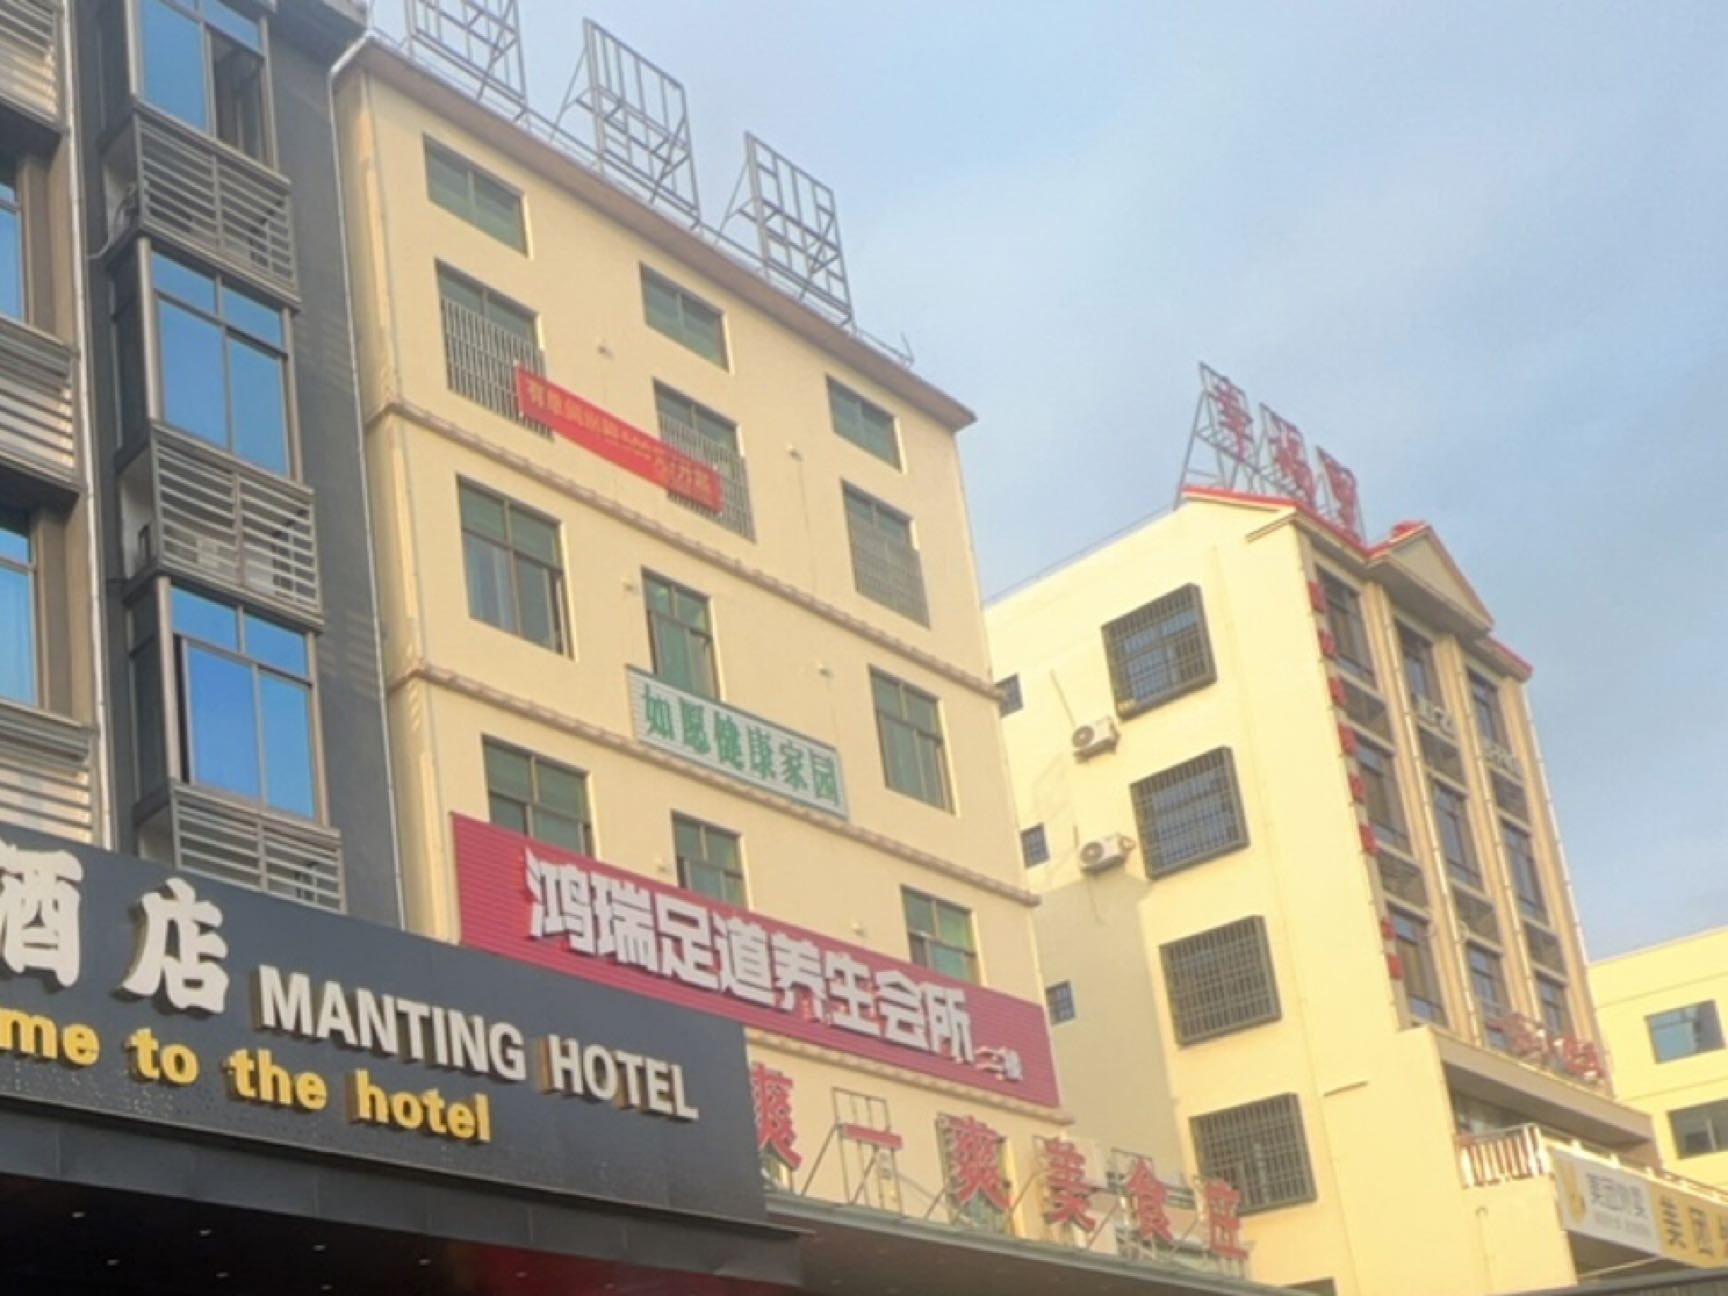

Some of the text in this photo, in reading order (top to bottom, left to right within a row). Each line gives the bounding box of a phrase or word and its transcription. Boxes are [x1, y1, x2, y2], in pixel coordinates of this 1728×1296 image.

[523, 846, 975, 1065] 鸿瑞足道养生会所
[128, 1027, 200, 1085] to
[225, 1048, 330, 1112] the
[349, 1069, 492, 1142] hotel
[254, 965, 699, 1121] MANTING HOTEL
